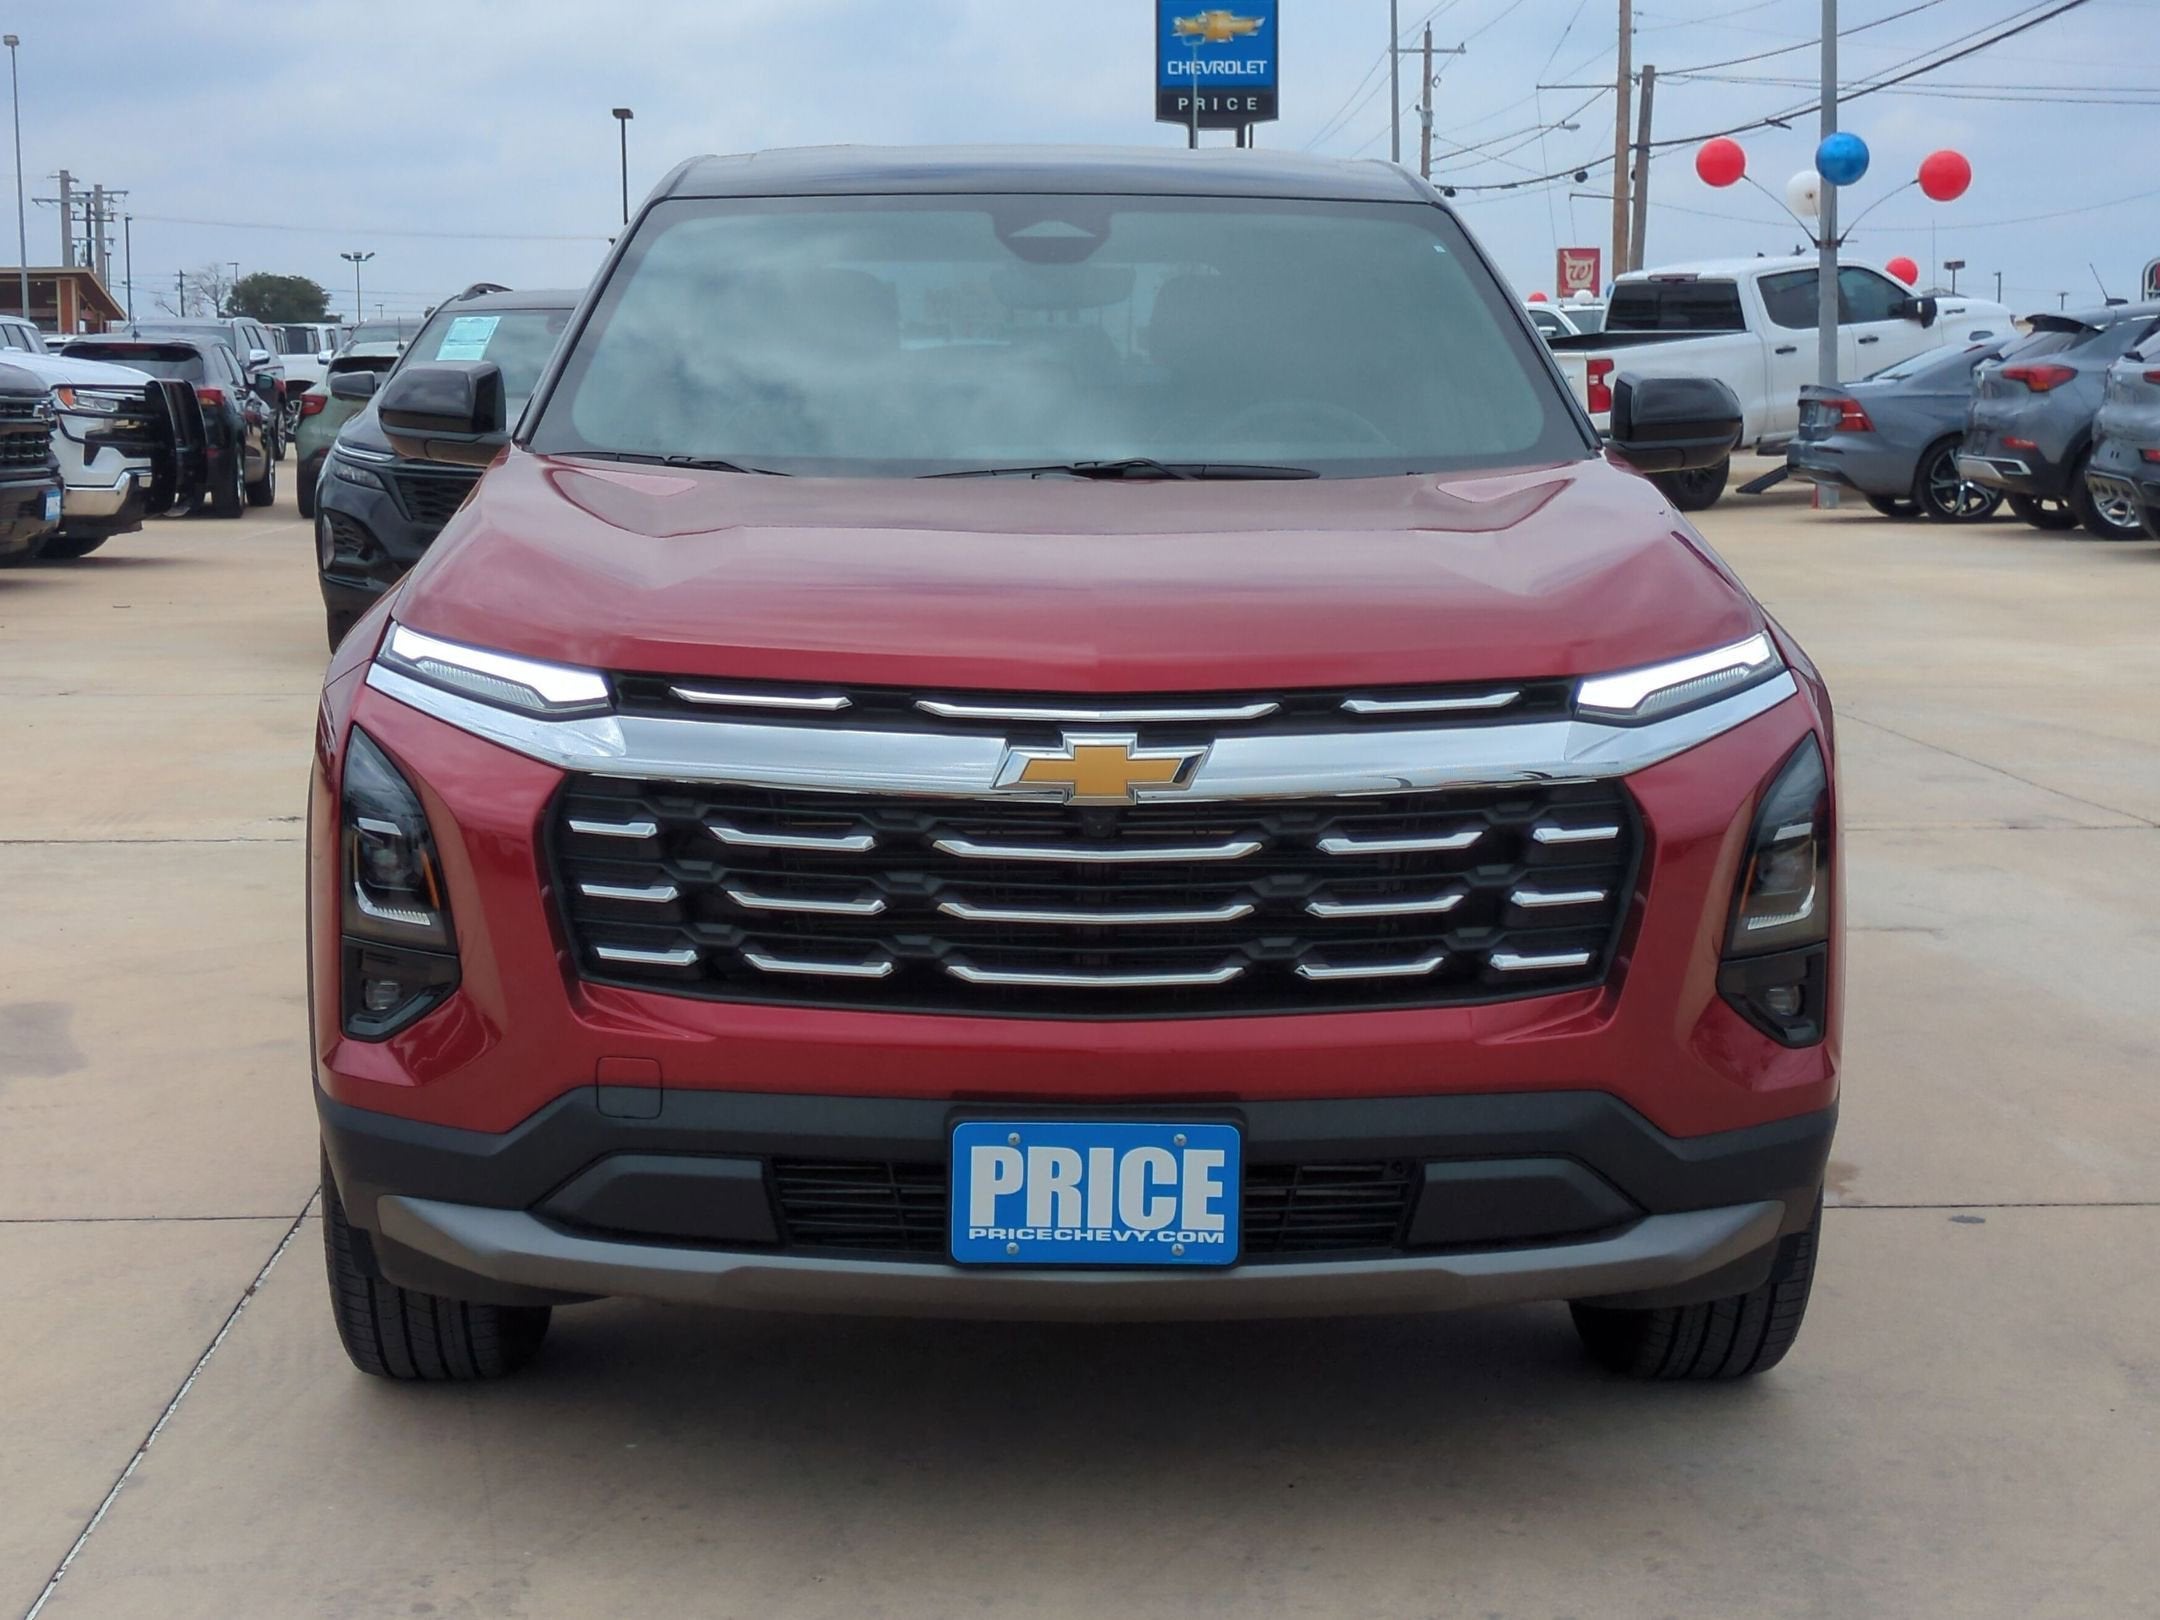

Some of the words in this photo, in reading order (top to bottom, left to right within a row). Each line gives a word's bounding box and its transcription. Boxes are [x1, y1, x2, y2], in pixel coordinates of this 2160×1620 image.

[1167, 60, 1268, 75] CHEVROLET
[1177, 97, 1258, 111] PRICE
[968, 1145, 1226, 1231] PRICE
[968, 1228, 1225, 1244] PRICECHEVY.COM
